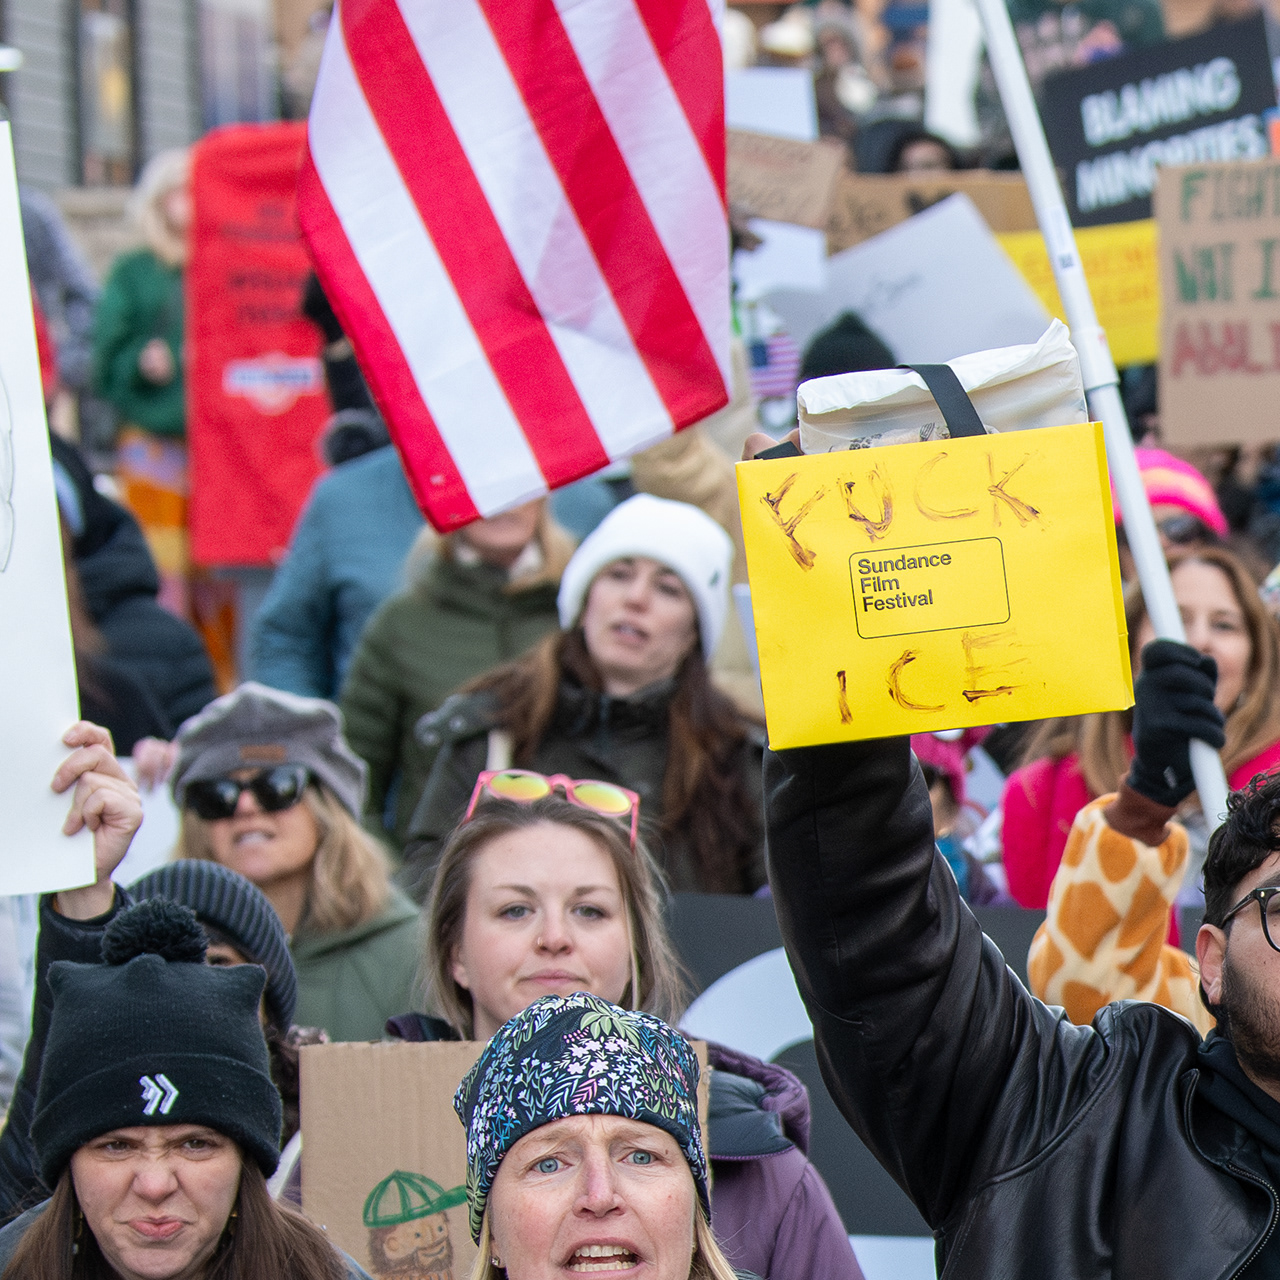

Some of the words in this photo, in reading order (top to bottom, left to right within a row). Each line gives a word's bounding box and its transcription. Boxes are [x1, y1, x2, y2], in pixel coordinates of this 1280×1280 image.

[1080, 56, 1241, 149] BLAMING
[760, 451, 1050, 573] FUCK
[857, 550, 952, 575] Sundance
[860, 575, 901, 594] Film
[862, 589, 934, 613] Festival
[837, 631, 1031, 725] ICE
